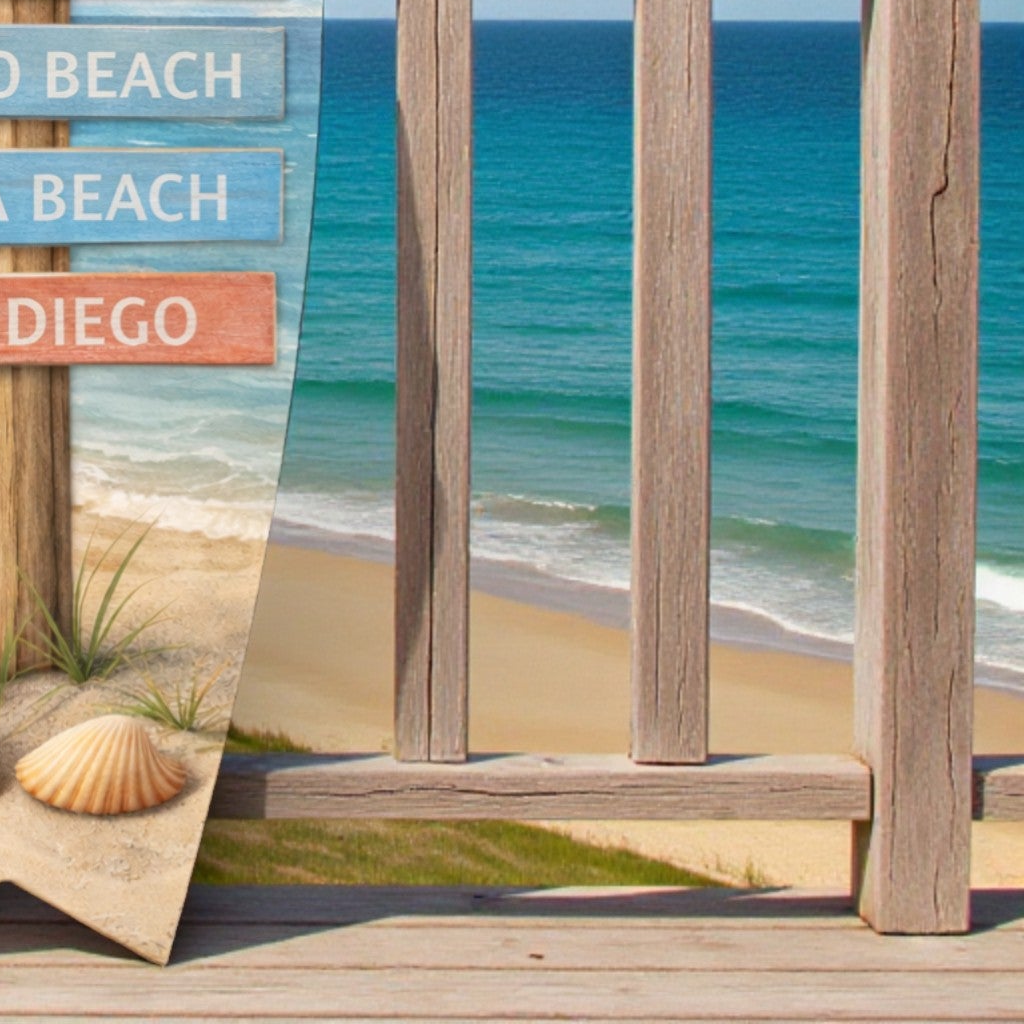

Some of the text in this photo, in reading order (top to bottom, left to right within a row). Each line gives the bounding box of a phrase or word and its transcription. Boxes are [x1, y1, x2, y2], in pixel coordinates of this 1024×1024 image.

[47, 49, 243, 100] BEACH
[33, 173, 228, 222] BEACH
[6, 297, 197, 347] DIEGO
